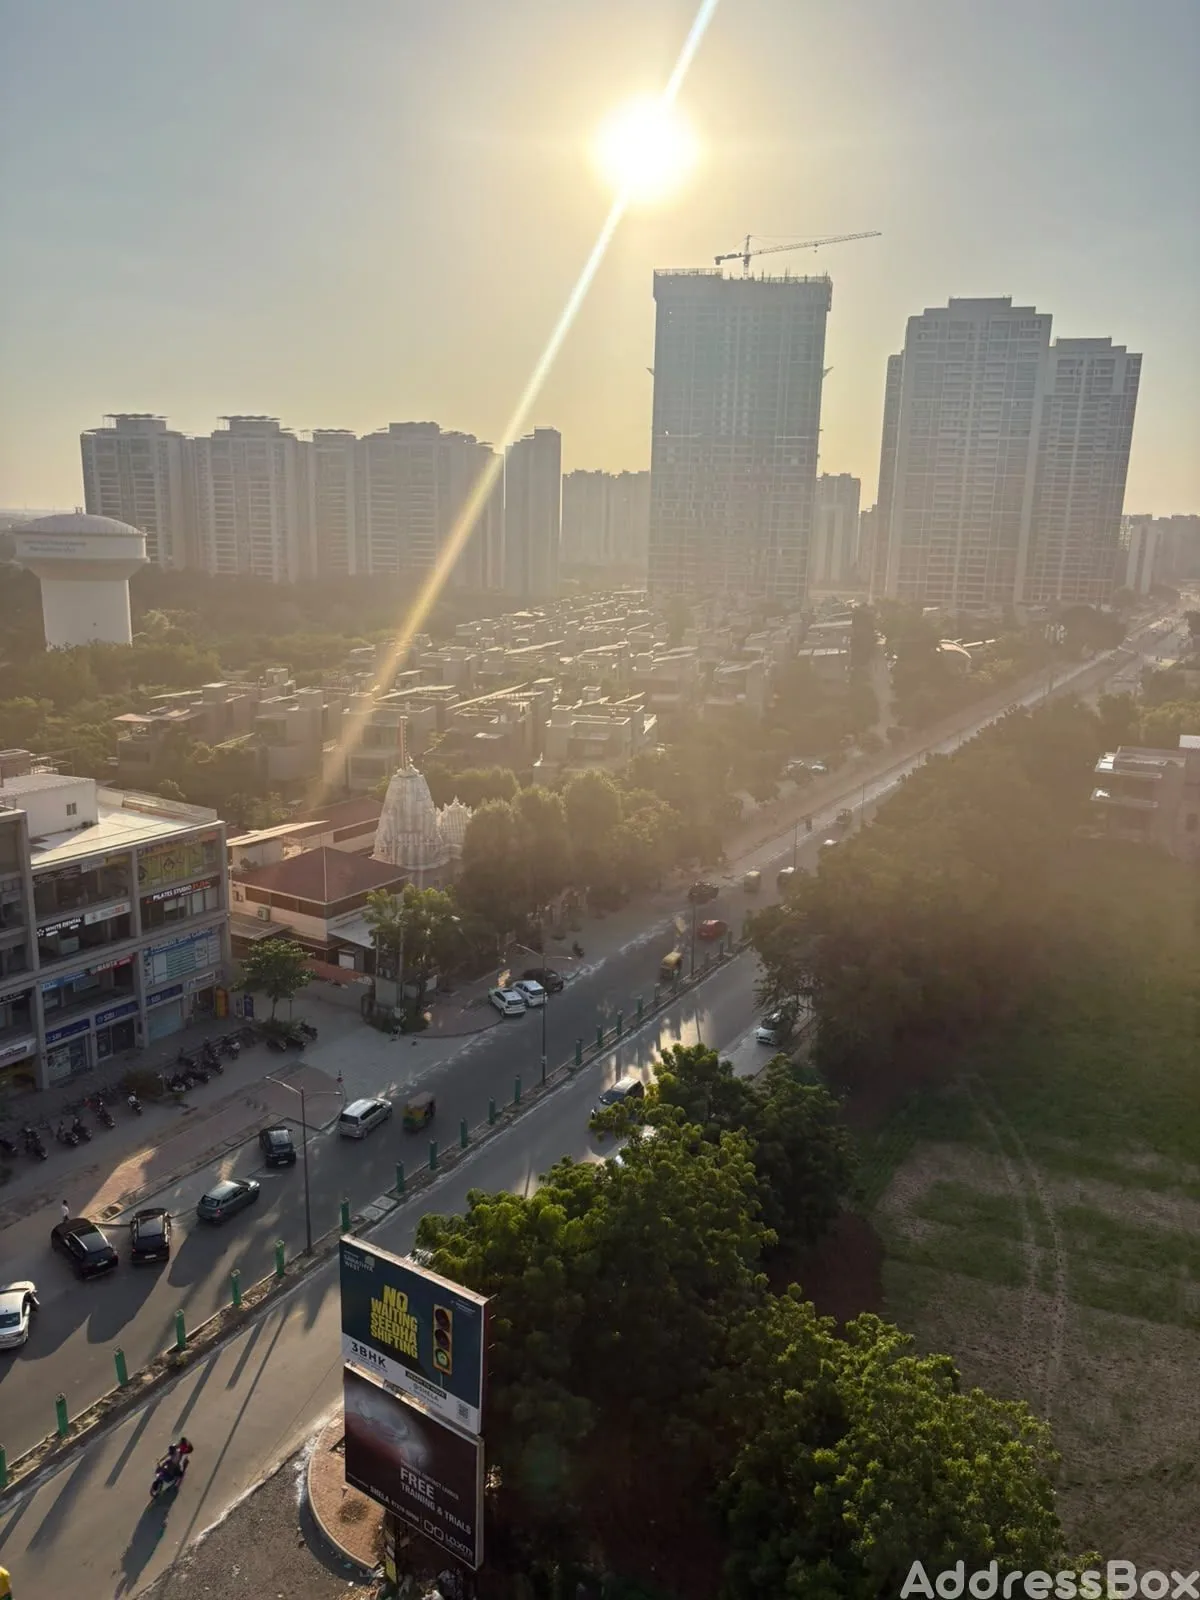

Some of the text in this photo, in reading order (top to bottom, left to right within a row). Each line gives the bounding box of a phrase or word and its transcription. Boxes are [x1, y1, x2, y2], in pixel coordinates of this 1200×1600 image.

[371, 1296, 418, 1333] WAITING
[384, 1284, 409, 1313] NO
[371, 1312, 417, 1345] SEEDHA
[371, 1324, 418, 1359] SHIFTING
[351, 1341, 386, 1369] 3BHK
[400, 1467, 434, 1500] FREE
[401, 1481, 435, 1511] TRAINING
[437, 1506, 443, 1516] &
[444, 1510, 472, 1535] TRIALS
